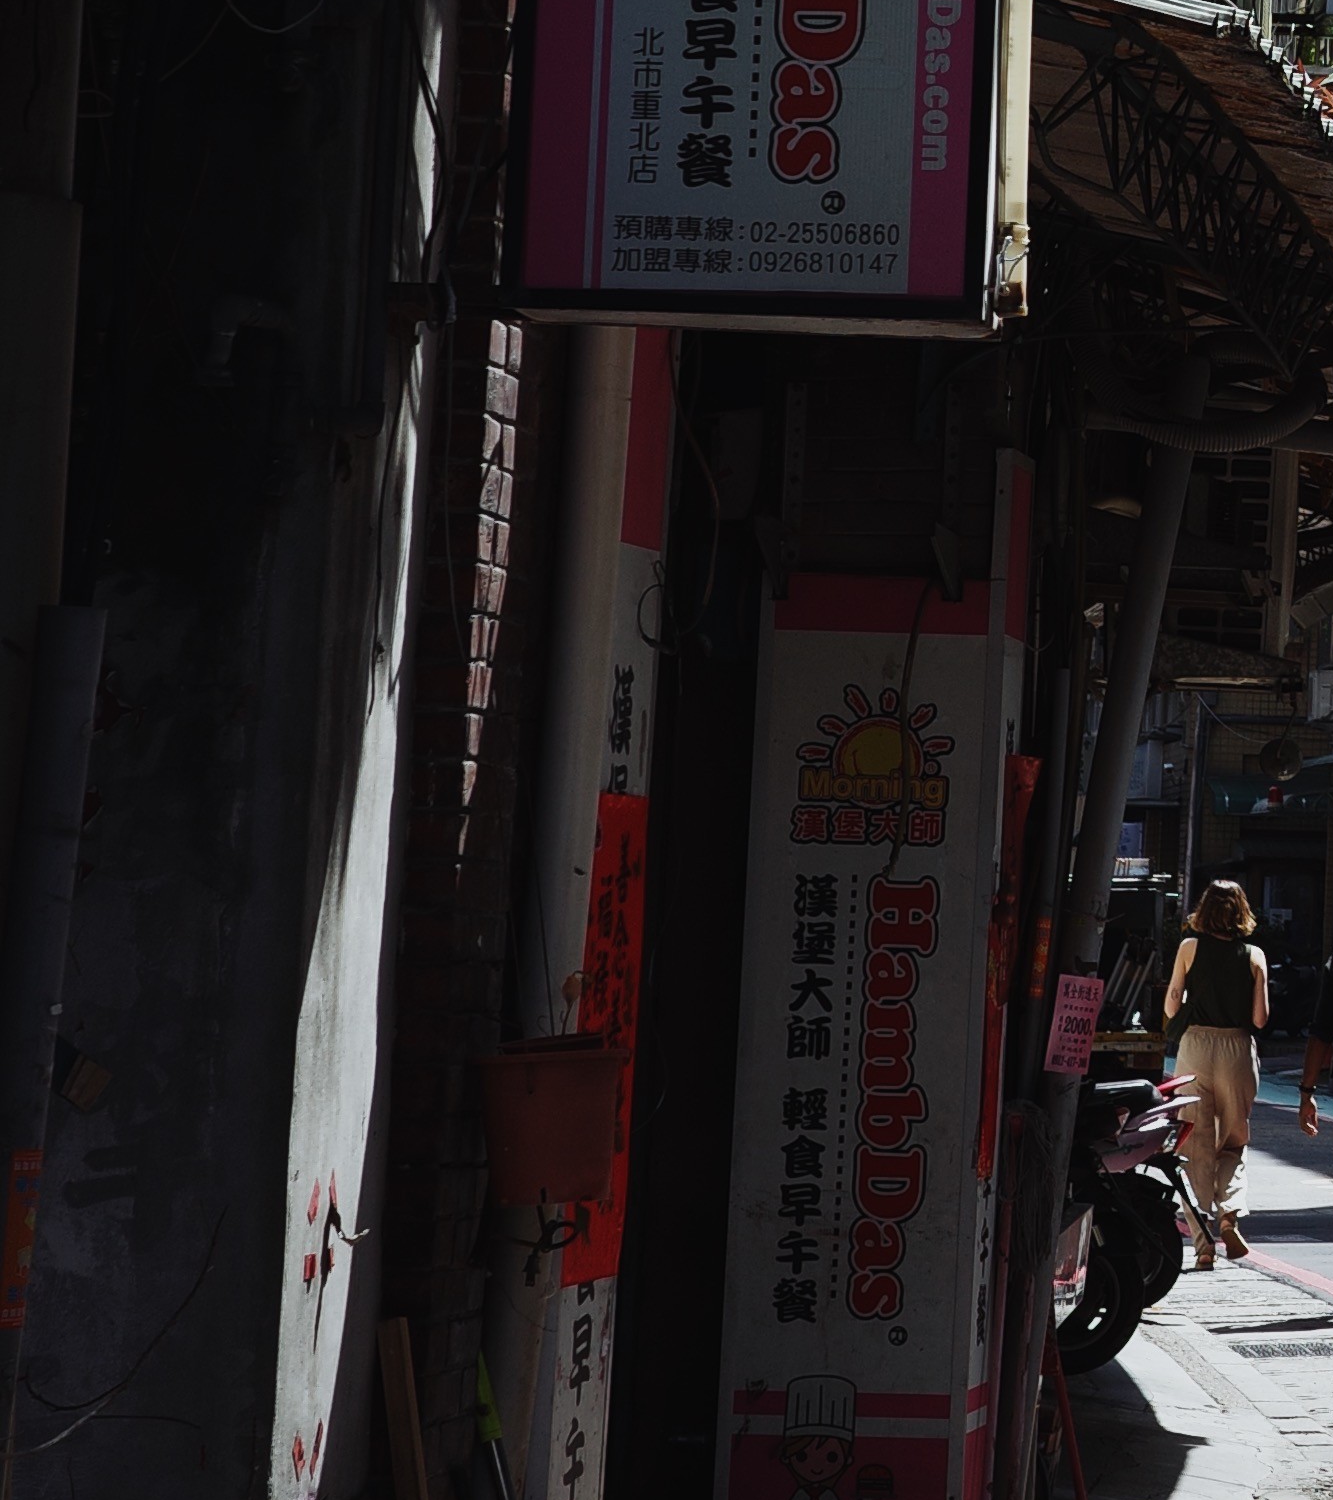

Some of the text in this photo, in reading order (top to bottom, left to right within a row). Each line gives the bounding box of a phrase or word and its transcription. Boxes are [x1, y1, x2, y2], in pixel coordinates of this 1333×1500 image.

[627, 27, 665, 184] 北市重北店
[790, 804, 946, 847] 漢堡大師
[799, 765, 949, 809] Morning
[771, 873, 840, 1324] 漢堡大師 輕食早午餐
[846, 874, 940, 1322] HambDas
